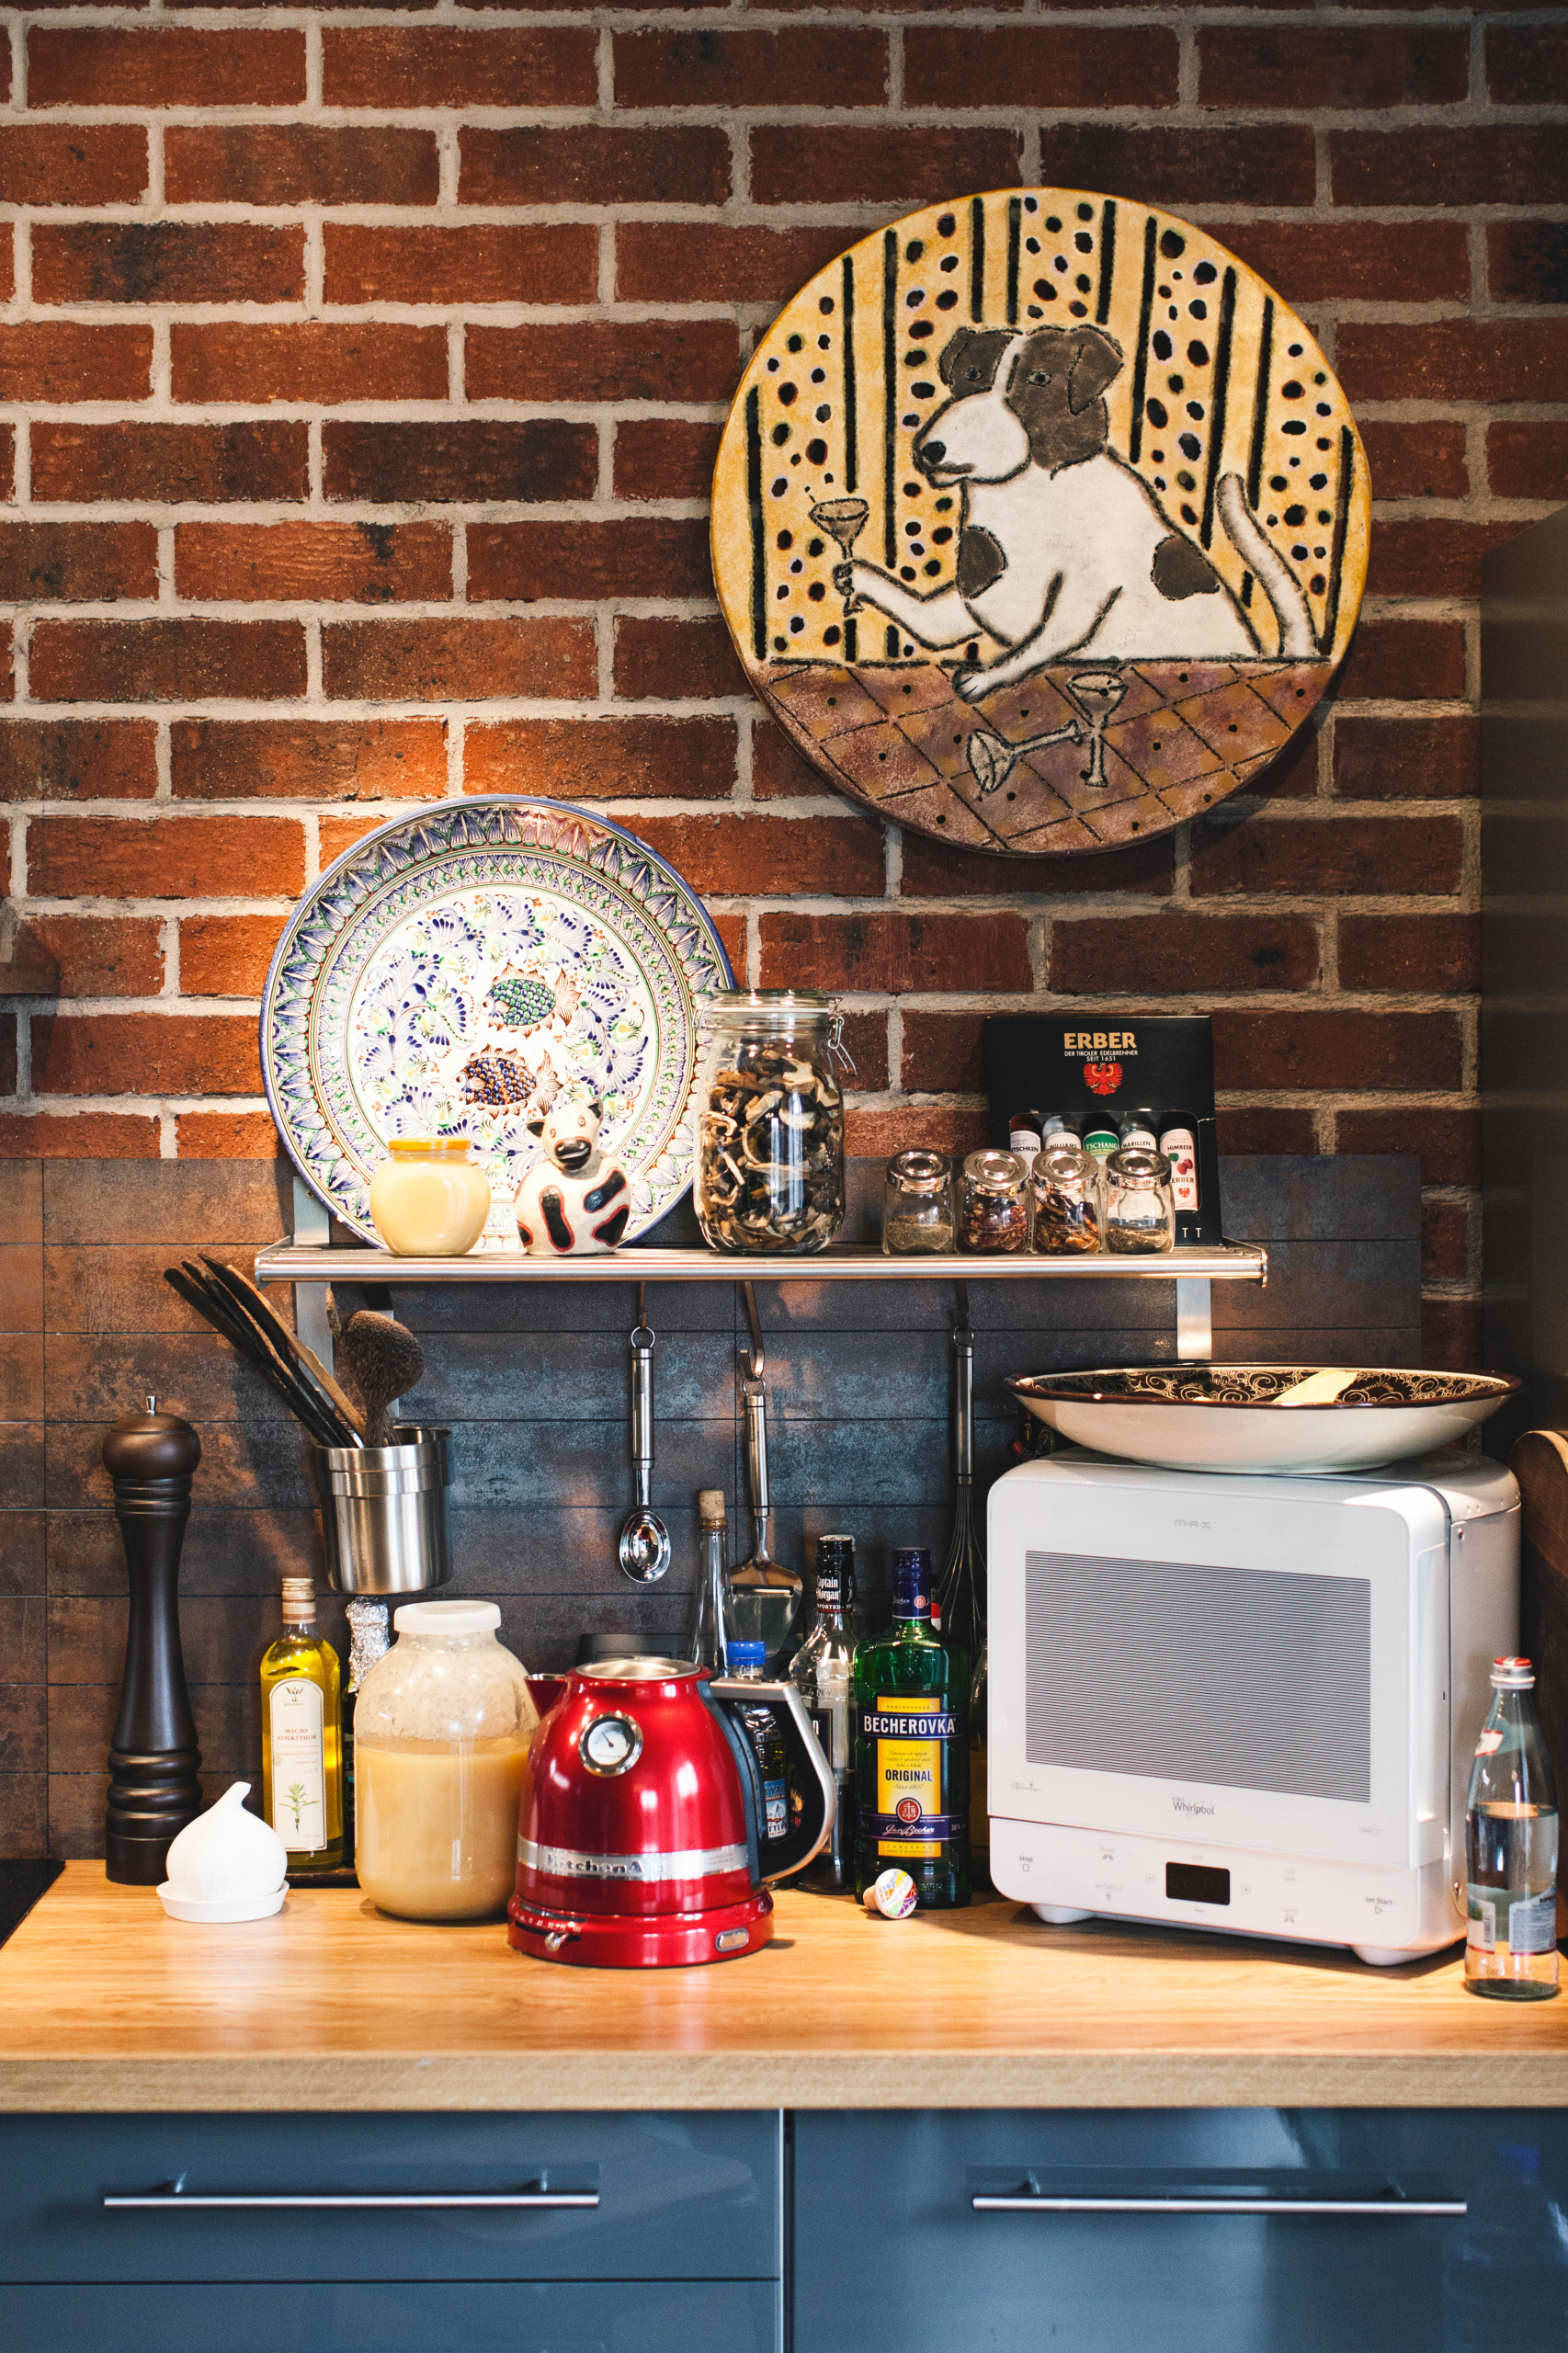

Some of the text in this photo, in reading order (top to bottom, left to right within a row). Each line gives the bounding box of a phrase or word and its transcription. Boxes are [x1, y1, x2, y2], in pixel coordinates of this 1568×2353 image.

[1063, 1031, 1137, 1050] ERBER
[864, 1715, 955, 1734] BECHEROVKA
[885, 1768, 933, 1782] ORIGINAL
[1173, 1801, 1214, 1816] Whirlpool
[1018, 1855, 1034, 1863] Stop
[1377, 1897, 1393, 1905] Start
